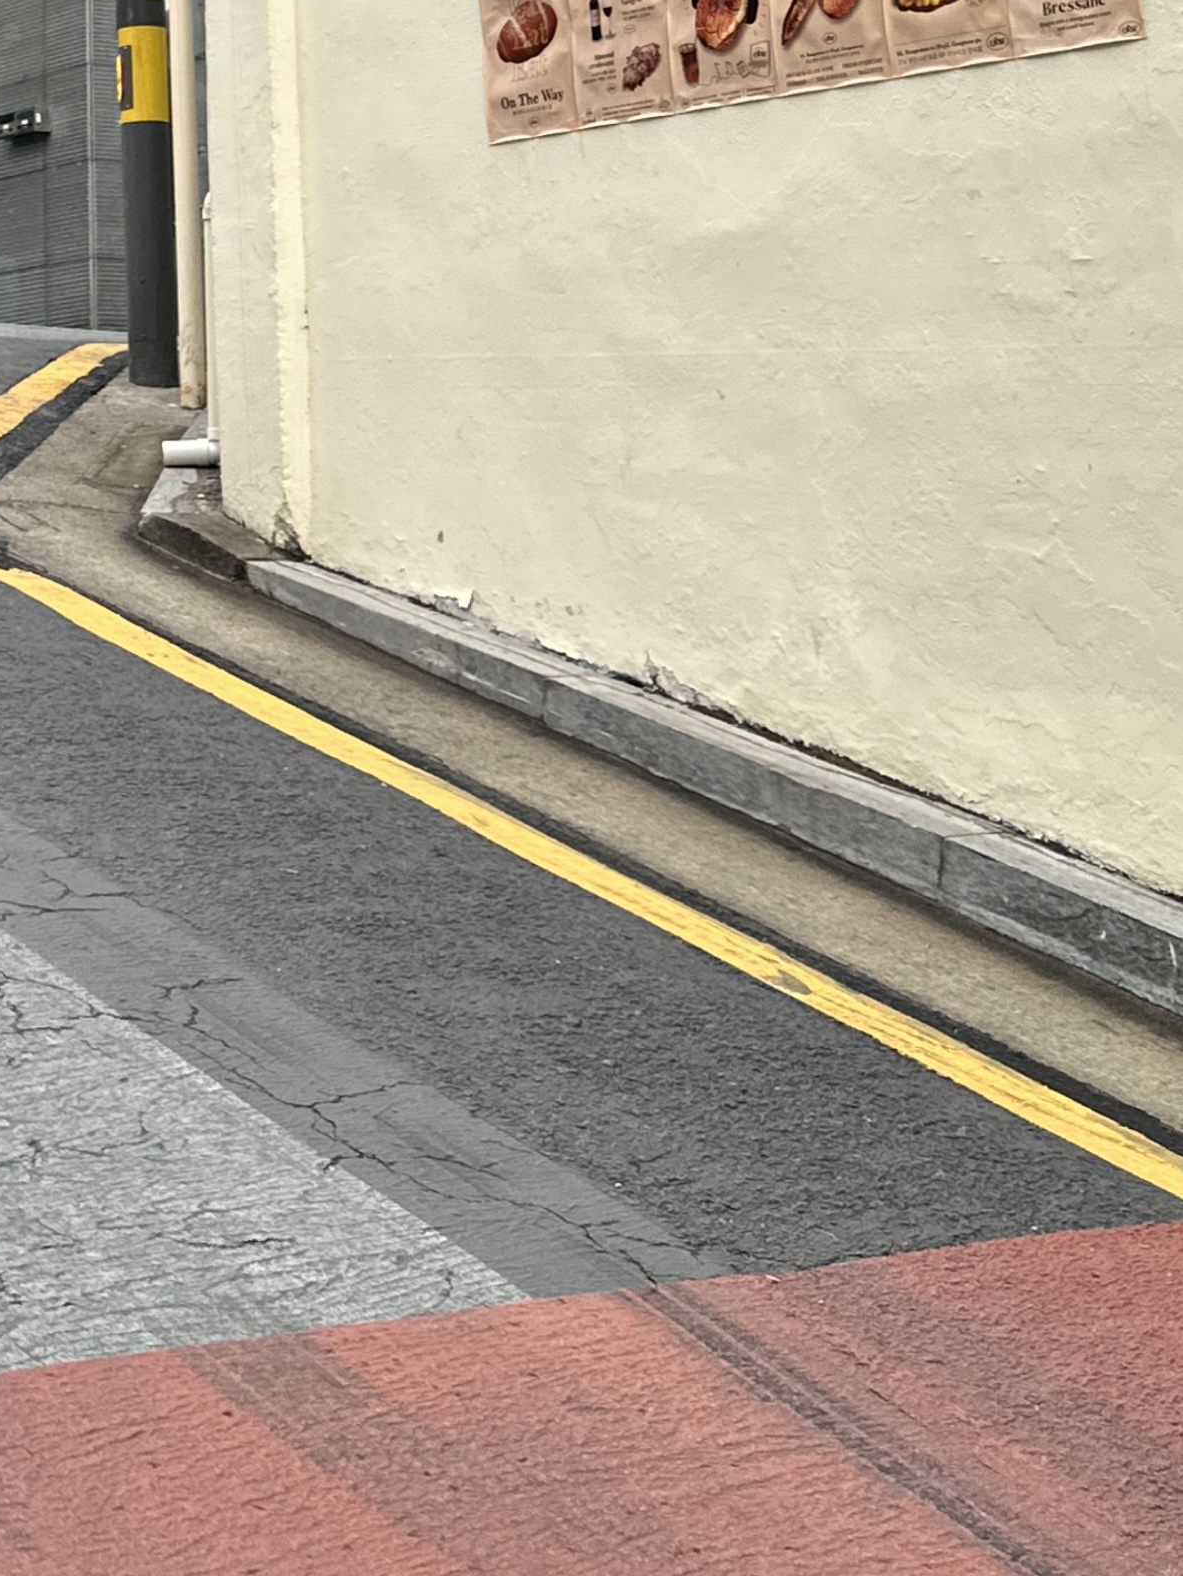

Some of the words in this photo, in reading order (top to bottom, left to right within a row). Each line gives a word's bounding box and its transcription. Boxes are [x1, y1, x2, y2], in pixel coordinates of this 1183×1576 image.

[500, 96, 516, 110] On
[518, 92, 539, 107] The
[541, 88, 564, 103] Way
